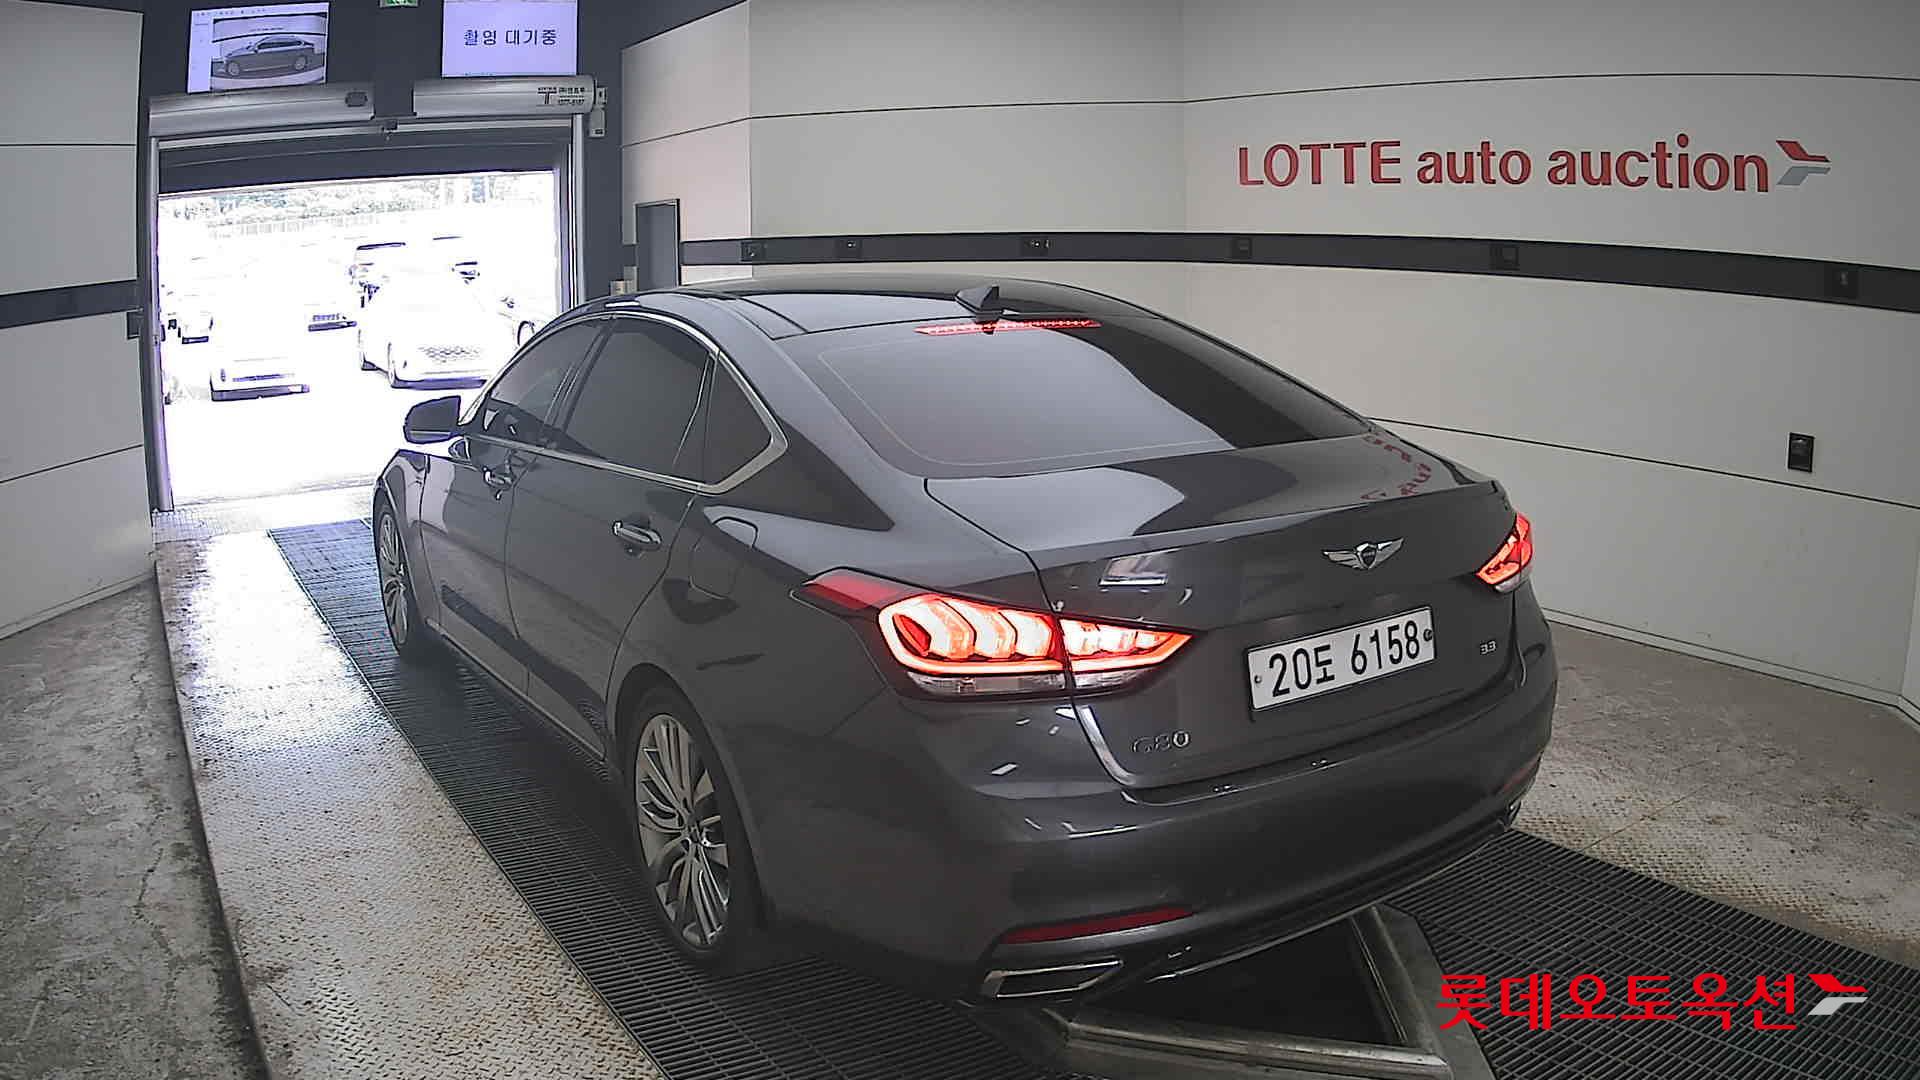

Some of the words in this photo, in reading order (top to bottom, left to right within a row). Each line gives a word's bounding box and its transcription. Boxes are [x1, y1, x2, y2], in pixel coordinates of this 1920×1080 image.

[505, 29, 558, 46] 대기중
[1238, 139, 1401, 187] LOTTE
[1416, 140, 1532, 185] auto
[1547, 134, 1769, 192] auction
[1268, 644, 1336, 698] 20도
[1350, 620, 1421, 676] 6158
[1131, 730, 1190, 752] G80
